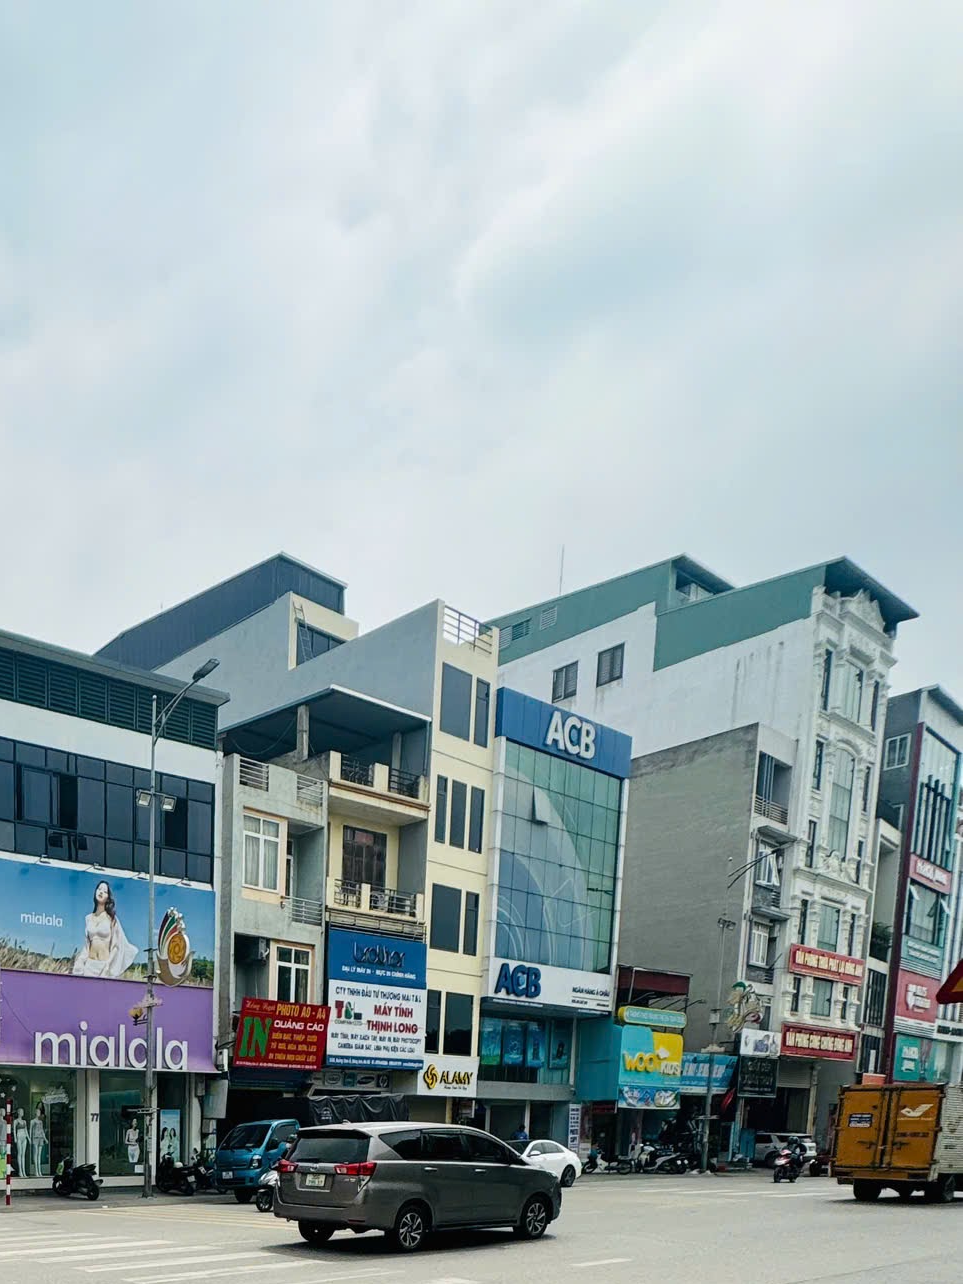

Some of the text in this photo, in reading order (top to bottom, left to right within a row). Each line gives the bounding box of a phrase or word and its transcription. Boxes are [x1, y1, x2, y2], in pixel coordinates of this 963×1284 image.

[545, 711, 597, 761] ACB
[20, 912, 63, 927] mialala
[494, 963, 542, 998] ACB
[276, 1003, 300, 1017] PHOTO
[374, 1002, 414, 1018] MÁY TÍNH
[273, 1018, 305, 1030] QUẢNG
[306, 1022, 325, 1032] CÁO
[366, 1020, 393, 1034] THỊNH
[394, 1022, 418, 1034] LONG
[238, 1016, 273, 1058] IN
[34, 1020, 188, 1070] mialala
[90, 1113, 100, 1122] 77
